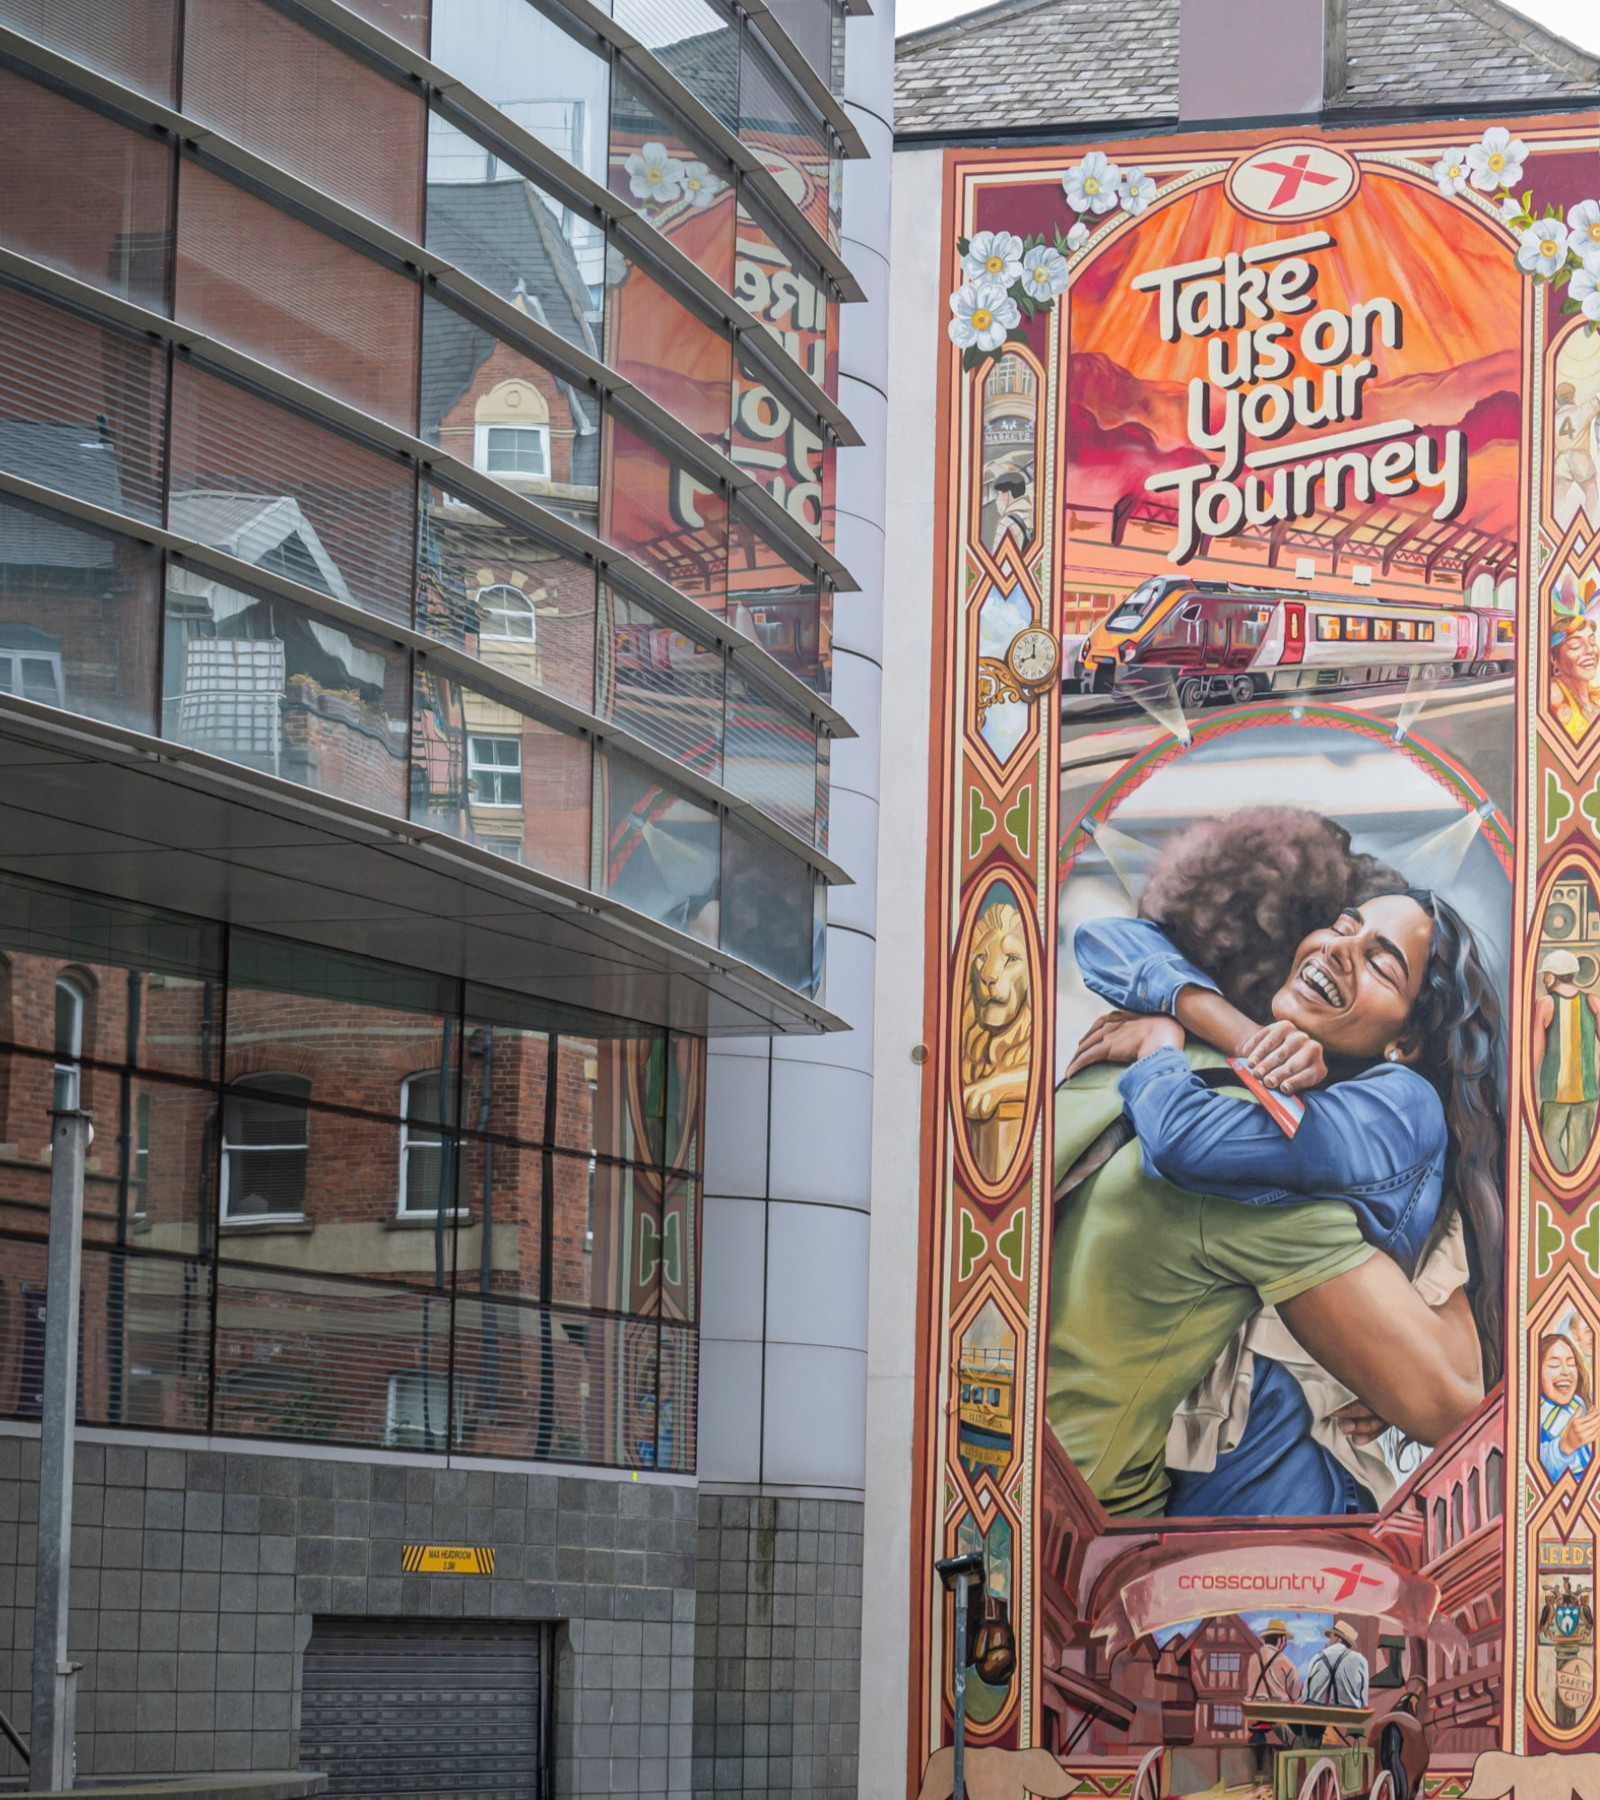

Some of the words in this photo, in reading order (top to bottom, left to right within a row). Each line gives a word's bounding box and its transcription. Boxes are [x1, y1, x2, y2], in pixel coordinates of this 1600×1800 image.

[1131, 231, 1336, 343] Take
[1207, 322, 1295, 389] us
[1300, 297, 1403, 366] on
[1188, 359, 1377, 481] your
[1558, 416, 1576, 440] 4
[1144, 419, 1467, 565] Journey
[428, 1549, 440, 1559] MAX
[441, 1550, 472, 1560] HEADROOM
[1540, 1544, 1593, 1565] LEEDS
[1178, 1573, 1325, 1594] crosscountry
[1574, 1664, 1581, 1674] A
[1559, 1674, 1592, 1690] SAFETY
[1564, 1691, 1586, 1702] CITY
